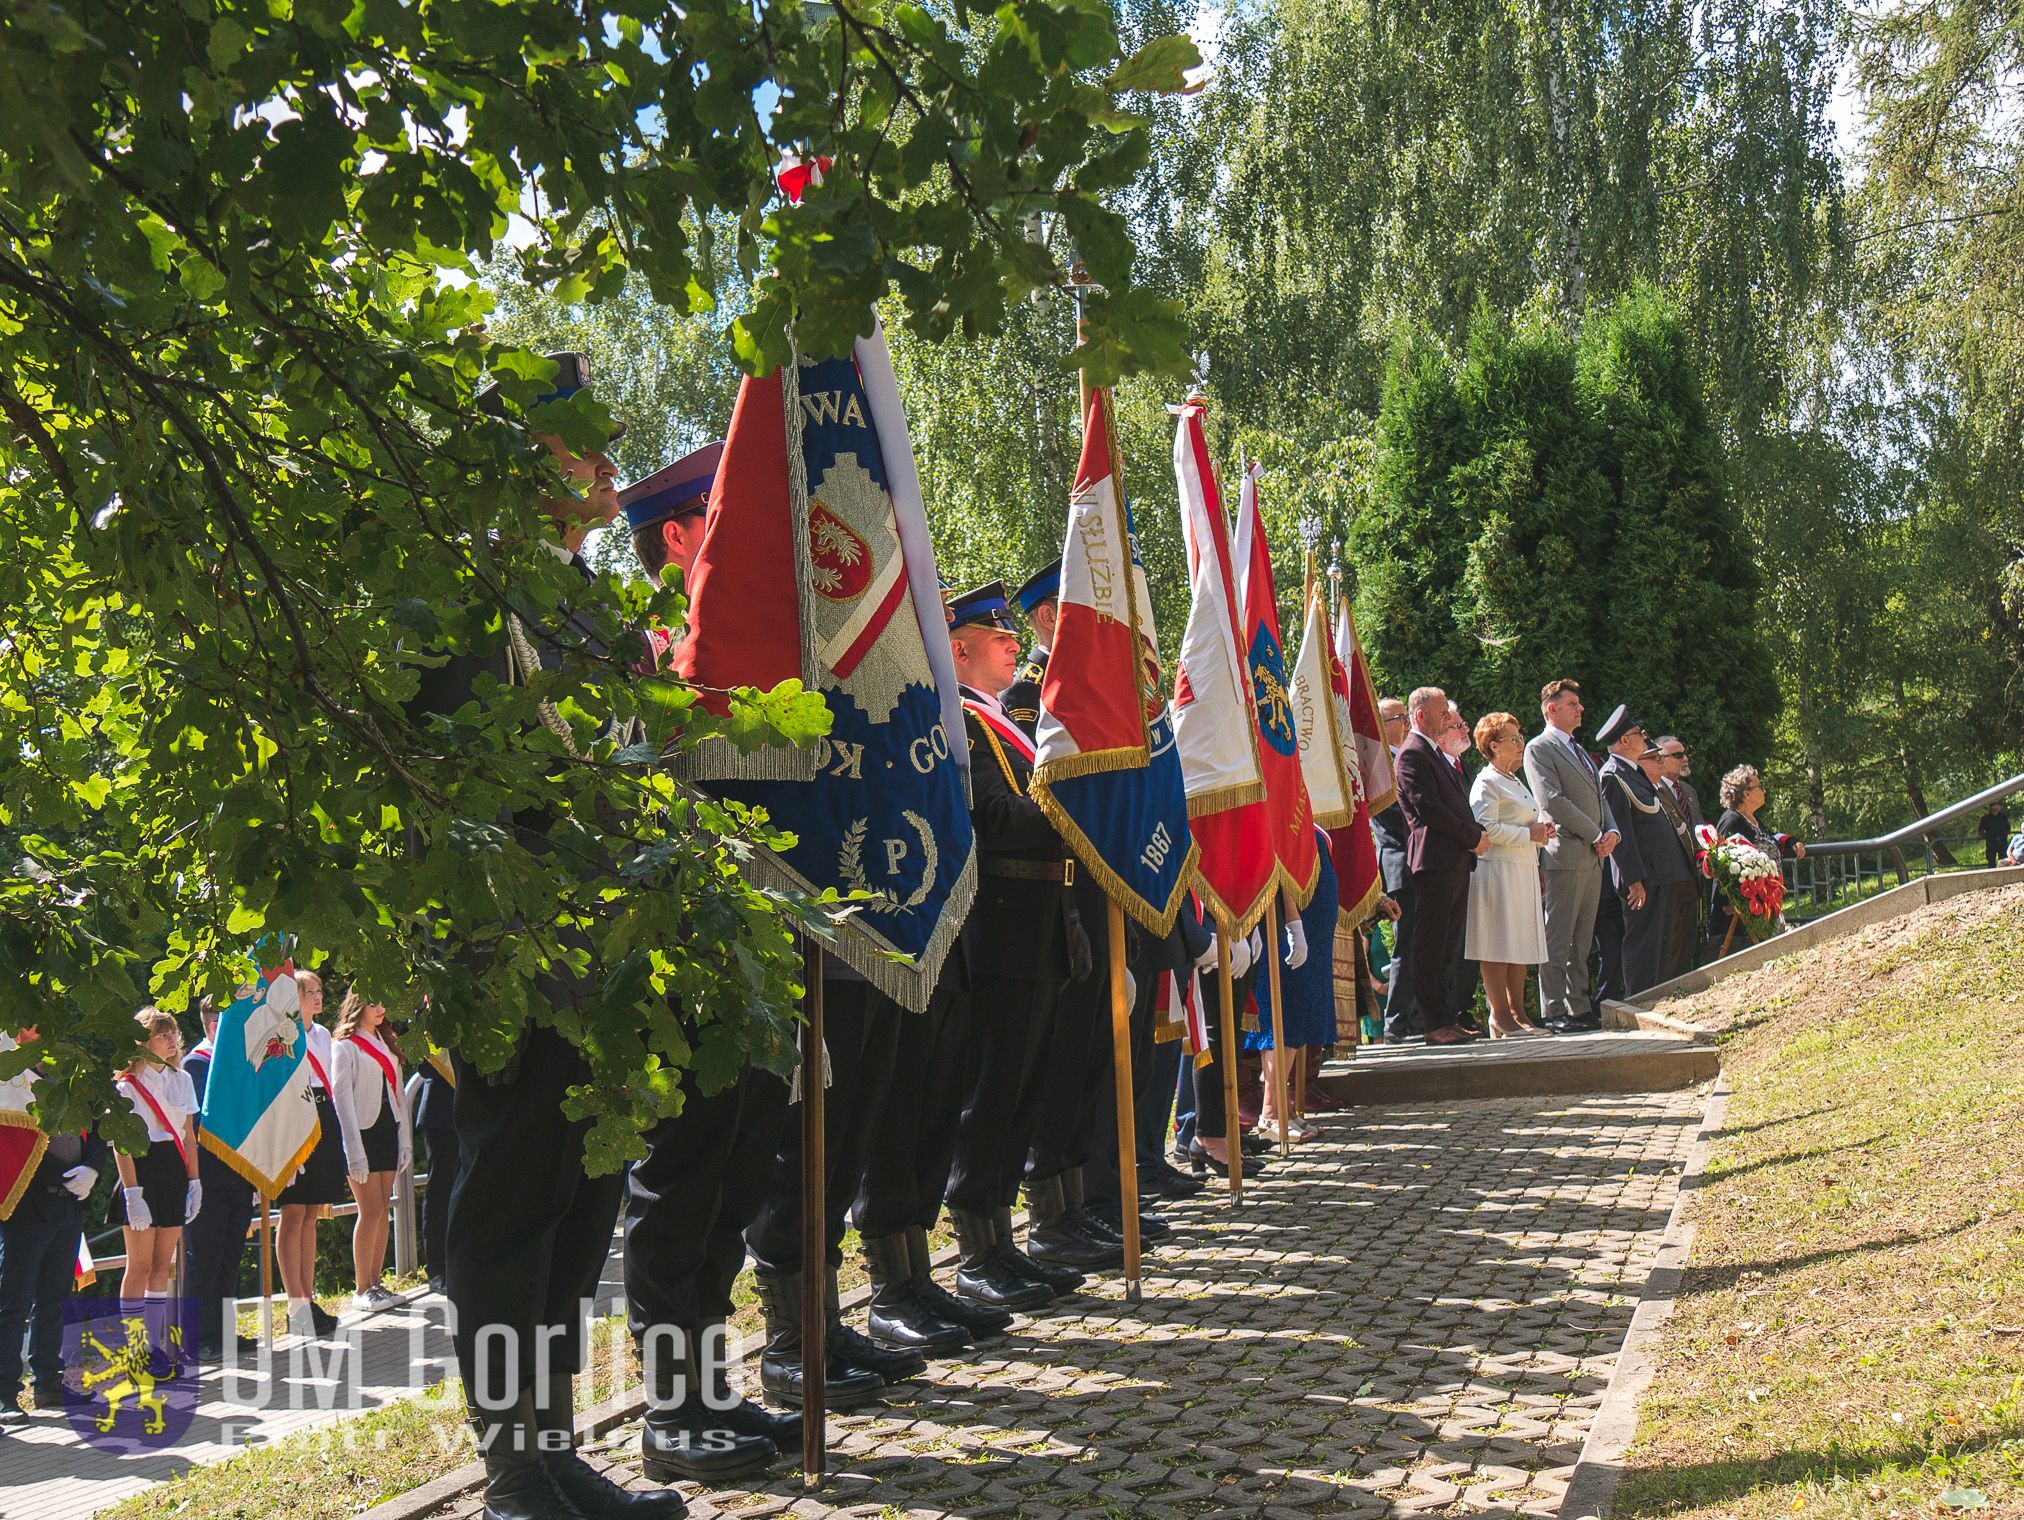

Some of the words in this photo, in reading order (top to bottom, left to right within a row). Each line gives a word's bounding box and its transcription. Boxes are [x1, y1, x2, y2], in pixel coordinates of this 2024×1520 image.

[1076, 514, 1115, 625] SŁUŻBIE
[1295, 675, 1314, 751] BRACTWO
[882, 838, 908, 875] P
[1140, 821, 1172, 874] 1867
